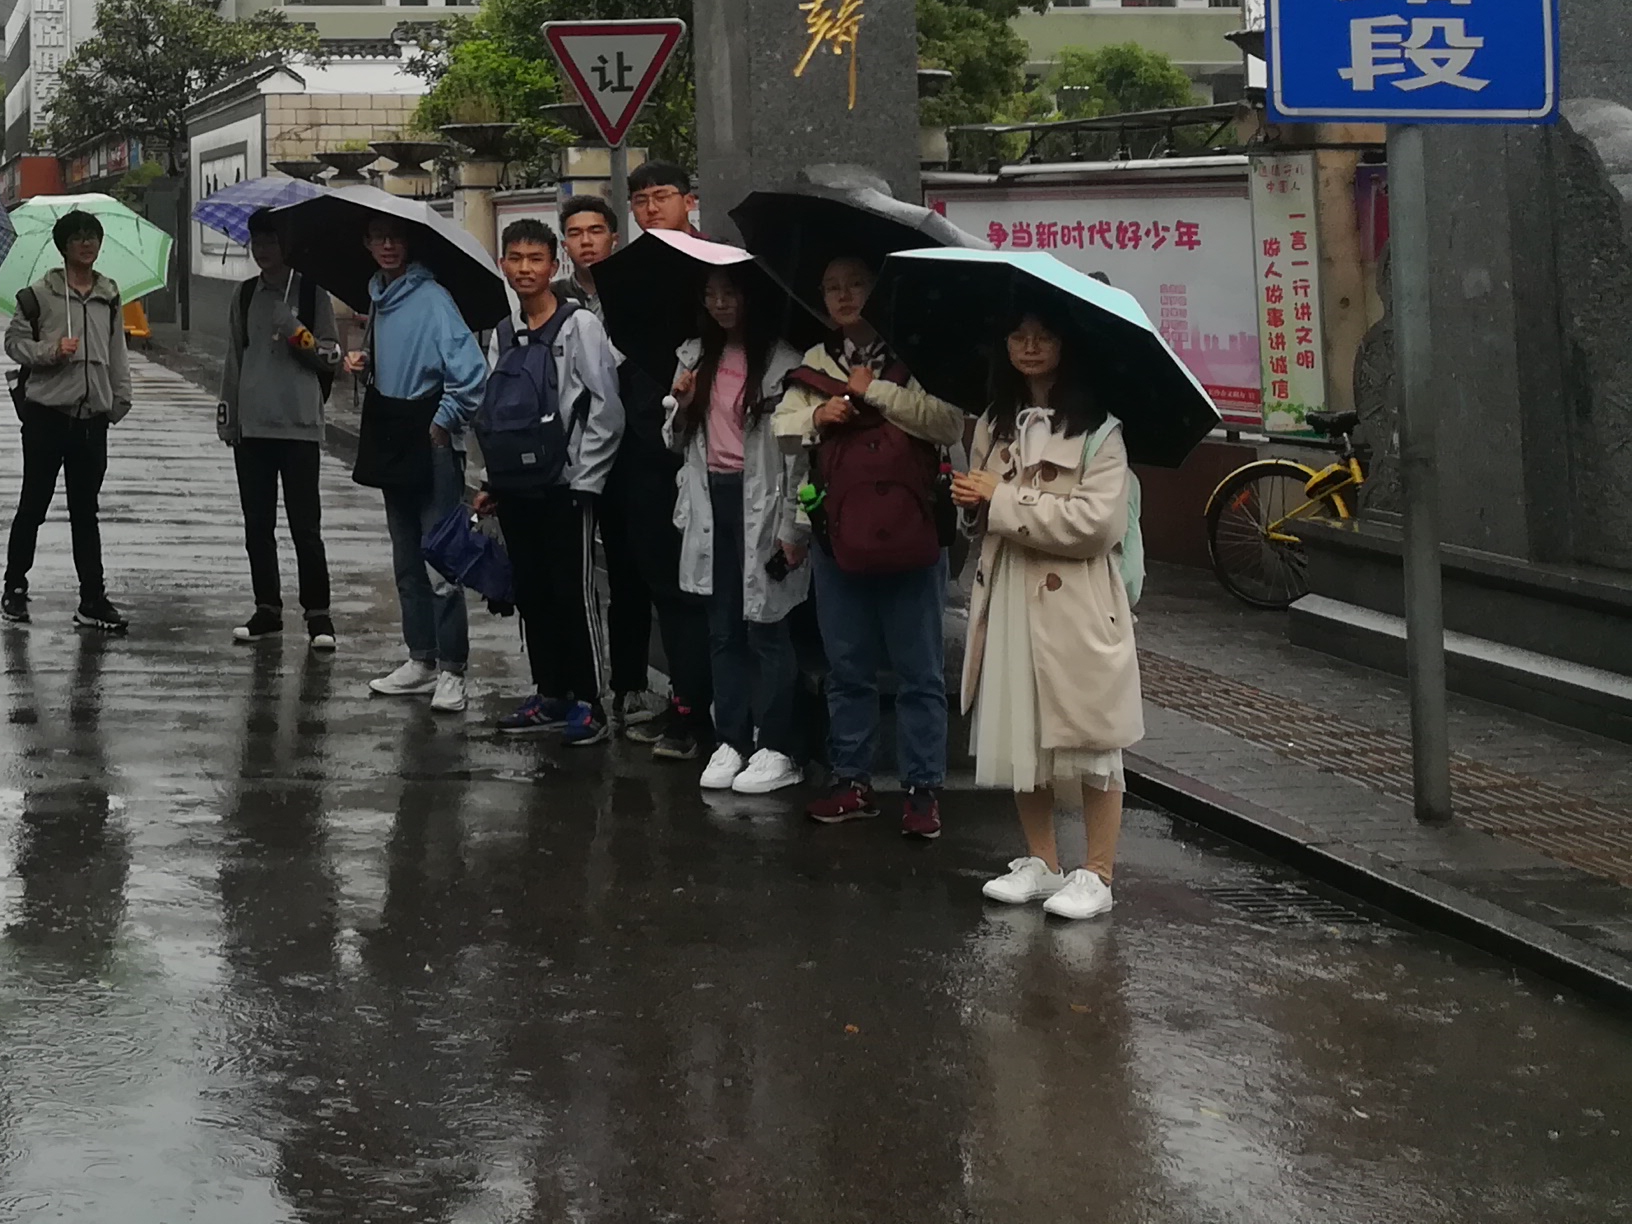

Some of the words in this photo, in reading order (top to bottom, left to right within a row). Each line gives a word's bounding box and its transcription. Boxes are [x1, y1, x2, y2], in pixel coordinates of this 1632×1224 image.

[590, 51, 635, 93] 让
[987, 220, 1202, 251] 争当新时代好少年
[1263, 237, 1289, 400] 做人做事讲诚信
[1289, 213, 1315, 370] 一言一行讲文明
